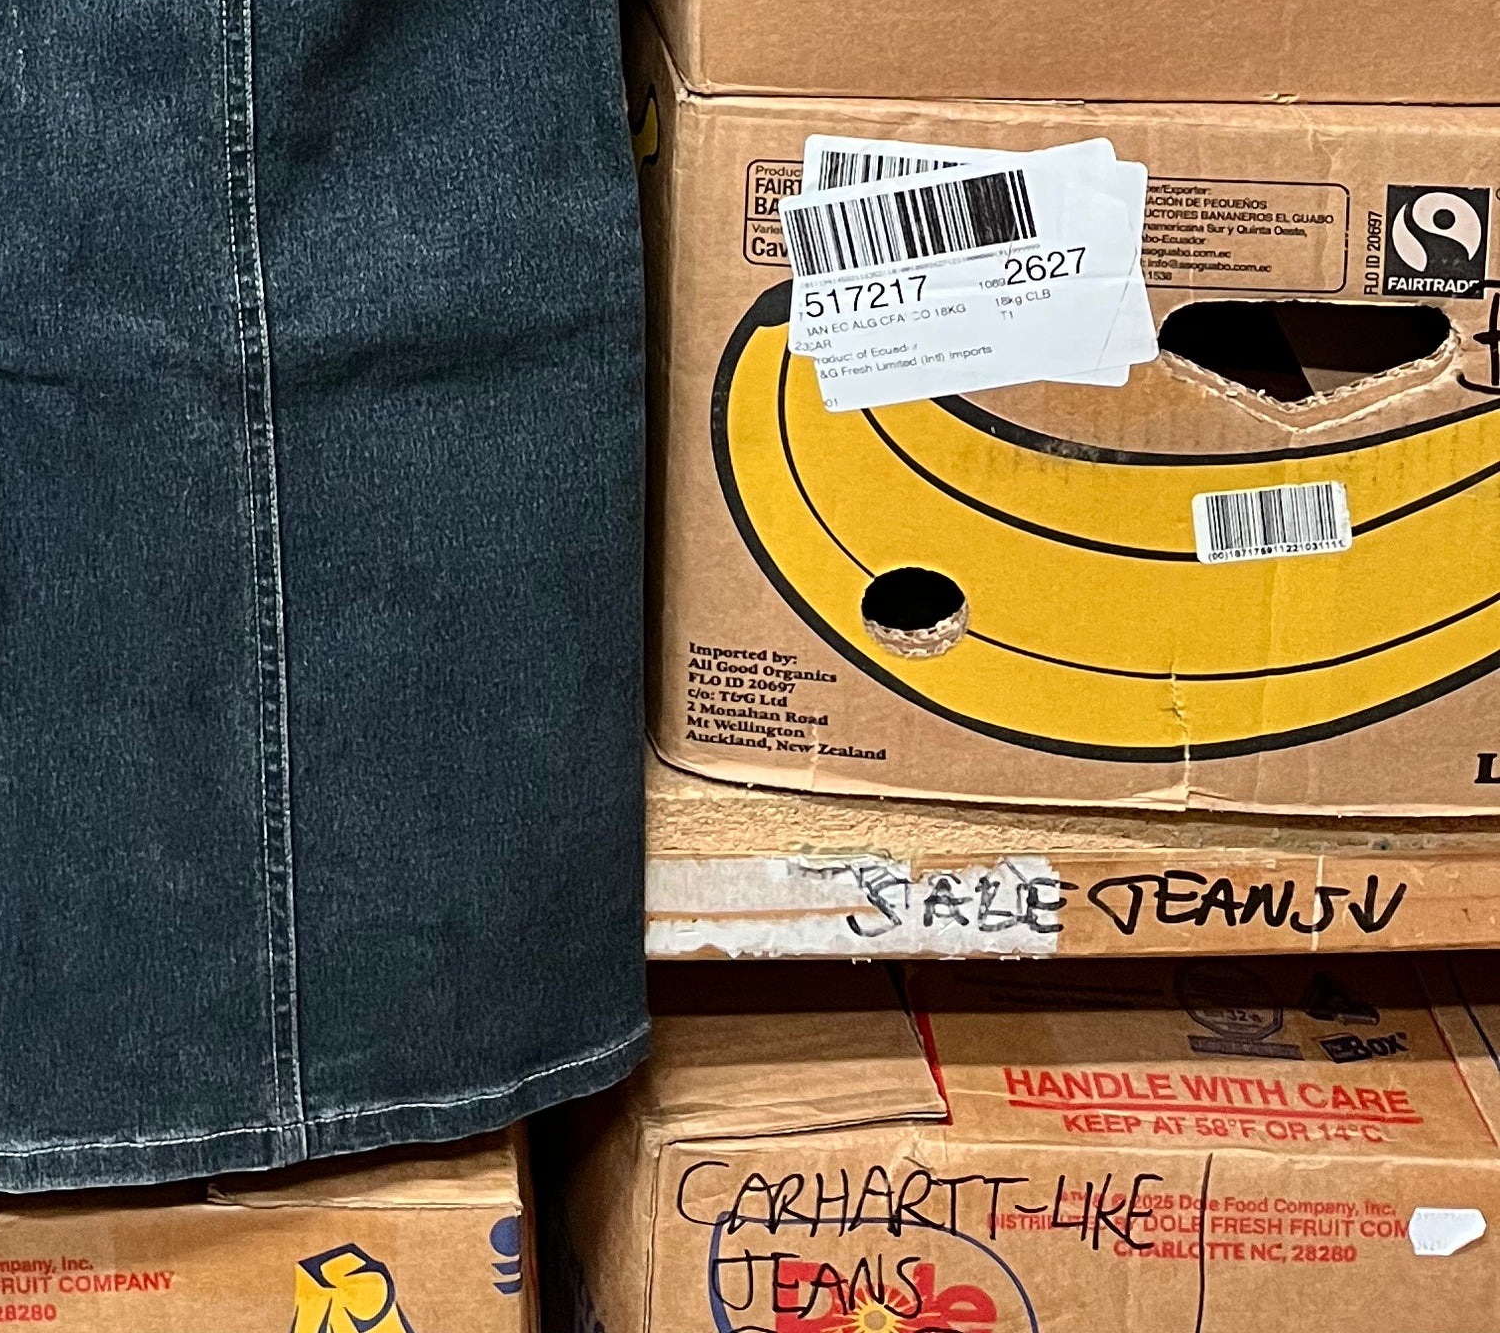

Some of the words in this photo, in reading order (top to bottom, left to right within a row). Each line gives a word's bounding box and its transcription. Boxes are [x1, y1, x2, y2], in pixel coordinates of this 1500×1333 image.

[804, 274, 928, 318] 517217
[1004, 247, 1087, 286] 2627
[689, 642, 767, 662] Imported
[763, 664, 837, 683] Organics
[714, 718, 805, 739] Wellington
[817, 742, 887, 761] Zealand
[1005, 1068, 1175, 1102] HANDLE
[1181, 1074, 1286, 1107] WITH
[1298, 1082, 1413, 1115] CARE
[1062, 1114, 1143, 1134] KEEP
[1151, 1116, 1186, 1136] AT
[1266, 1120, 1311, 1141] OR
[1225, 1195, 1268, 1214] Food
[1273, 1198, 1358, 1218] Company,
[1210, 1217, 1285, 1237] FRESH
[1289, 1219, 1354, 1238] FRUIT
[1291, 1244, 1358, 1264] 28280
[58, 1269, 176, 1294] COMPANY
[713, 1249, 924, 1320] JEANS
